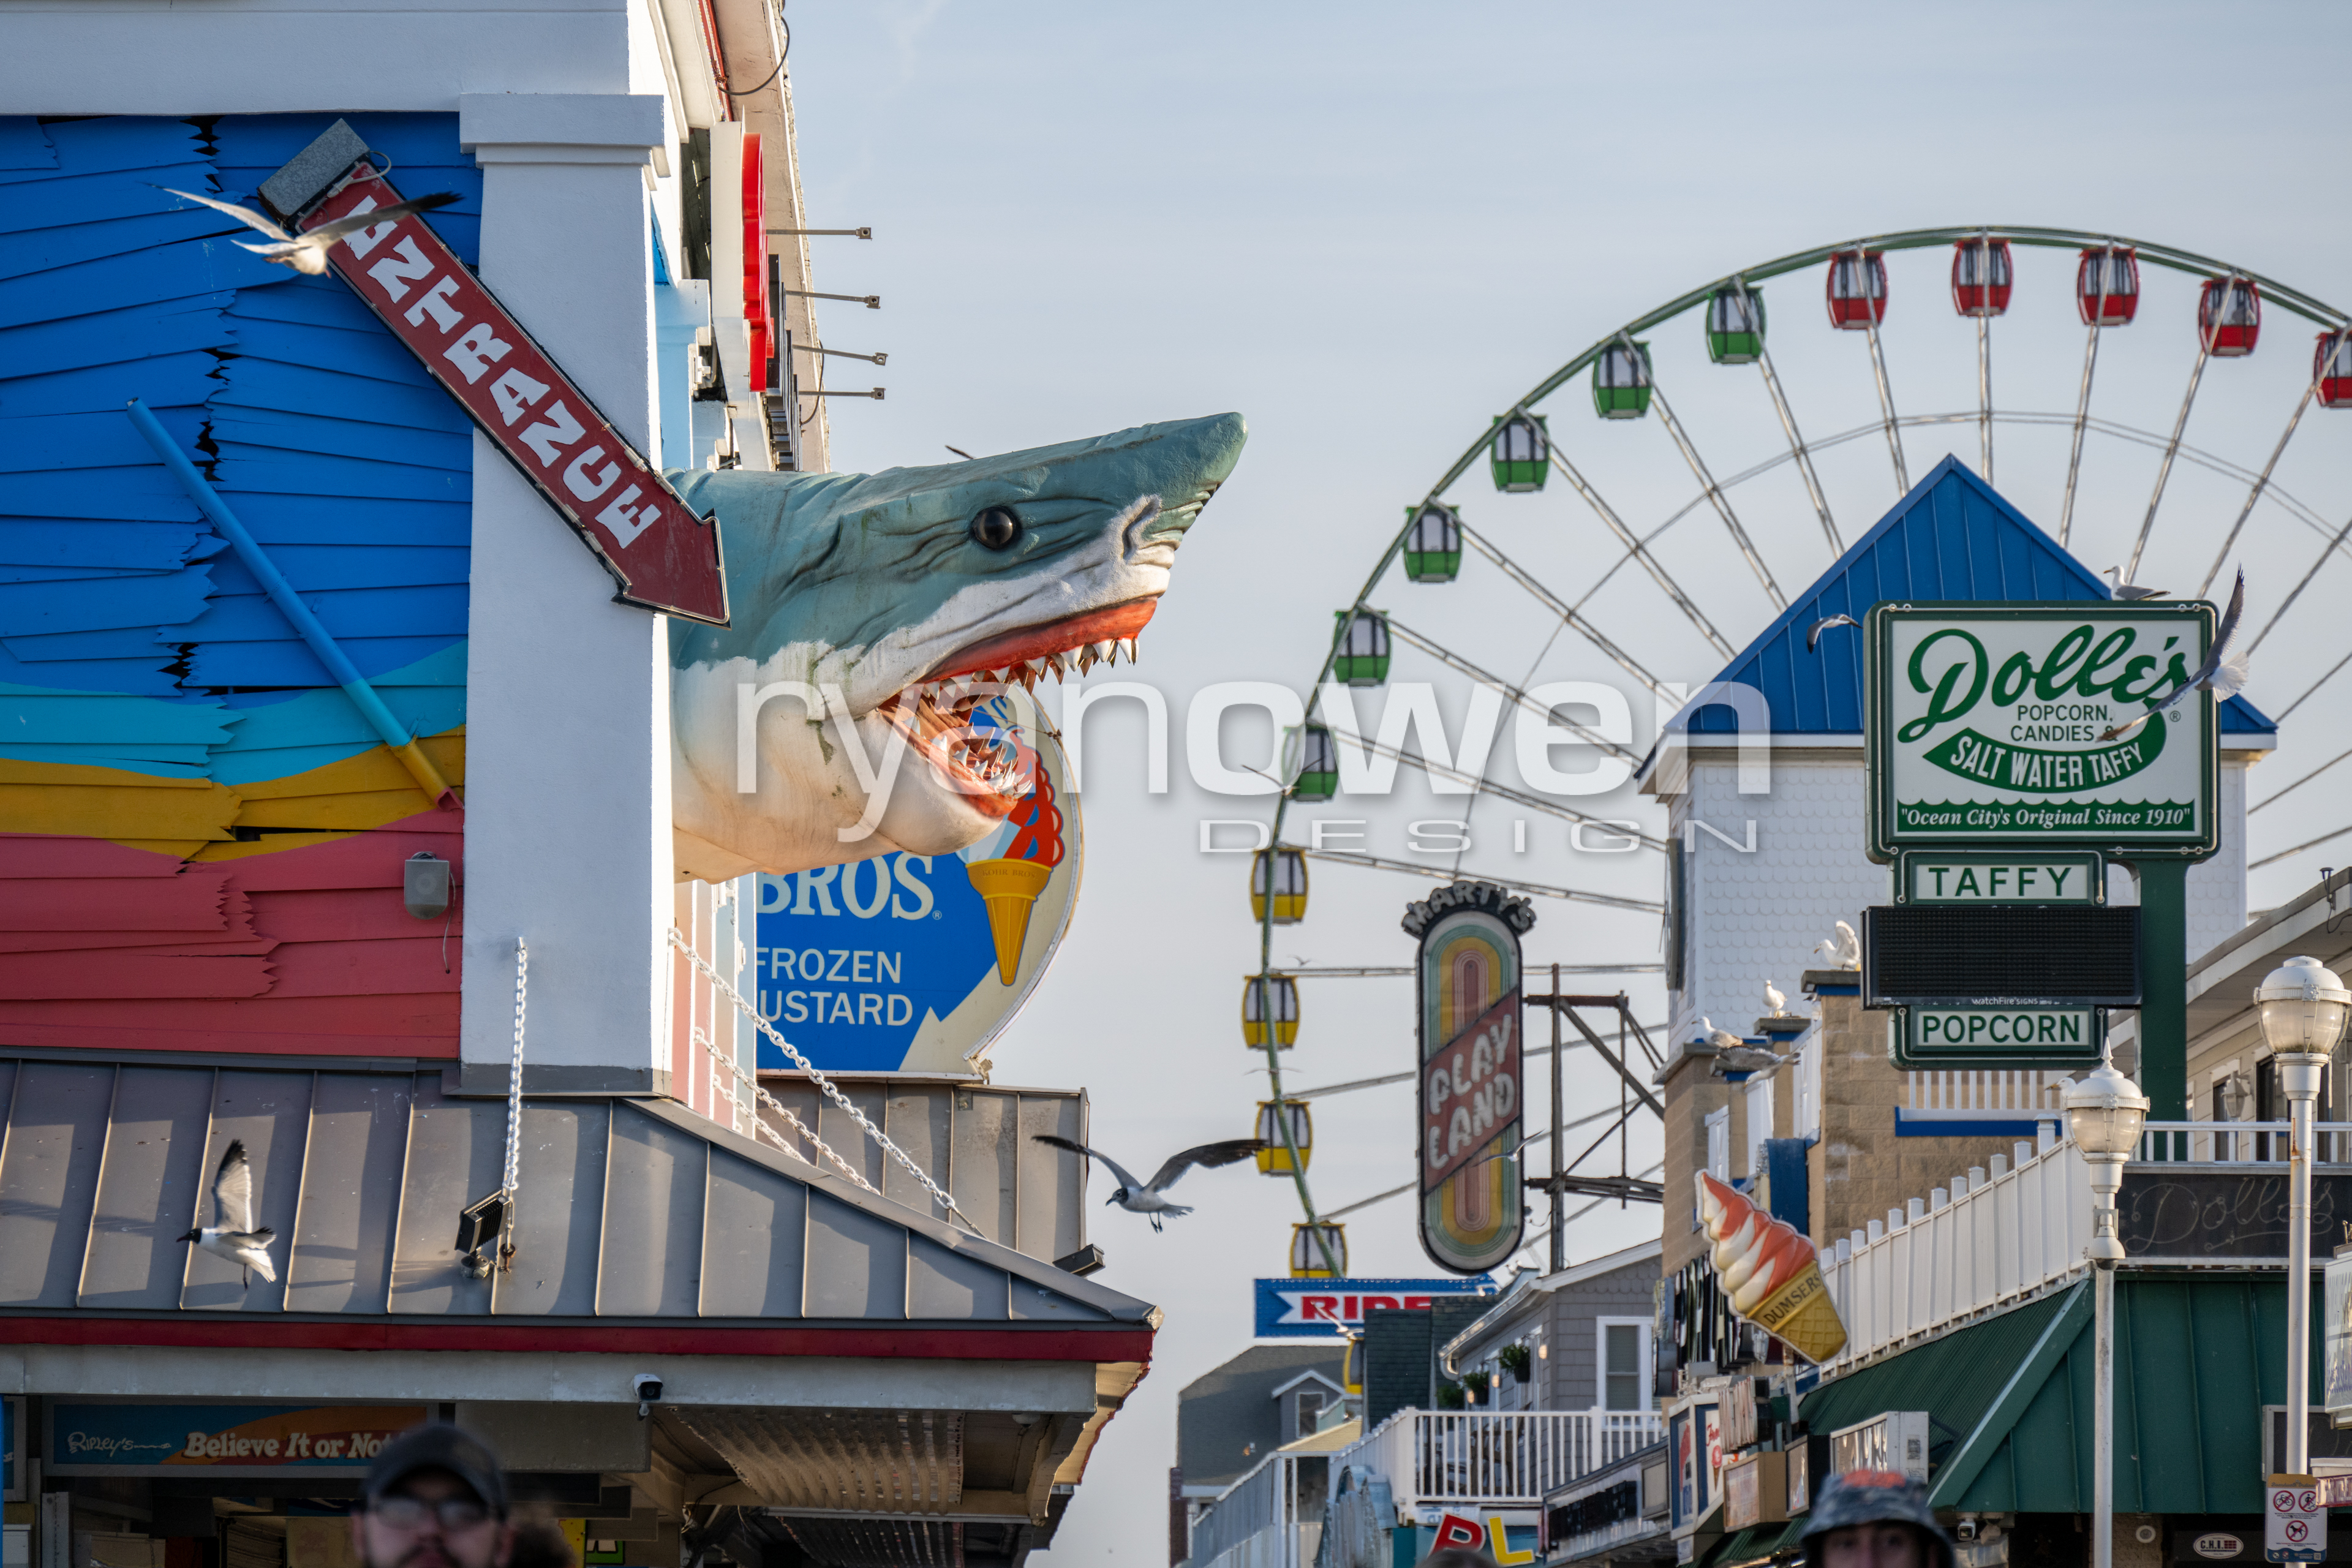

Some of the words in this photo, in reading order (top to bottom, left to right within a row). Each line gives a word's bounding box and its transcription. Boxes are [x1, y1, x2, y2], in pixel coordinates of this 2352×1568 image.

[341, 195, 662, 549] ENTRANCE
[1898, 624, 2192, 742] Dolle's
[2018, 704, 2114, 722] POPCORN,
[2010, 725, 2095, 742] CANDIES
[1950, 736, 2007, 780] SALT
[2010, 751, 2084, 788] WATER
[2088, 742, 2144, 783] TAFFY
[1901, 808, 1961, 825] "Ocean
[1966, 808, 2010, 829] City's
[2016, 808, 2090, 829] Original
[2095, 809, 2141, 825] Since
[2145, 808, 2191, 825] 1910"
[982, 869, 1008, 877] KOHR
[1928, 867, 2072, 897] TAFFY
[759, 989, 913, 1027] USTARD
[1922, 1014, 2081, 1043] POPCORN
[1429, 1014, 1512, 1115] PLAY
[1428, 1073, 1516, 1170] LAND
[1763, 1273, 1822, 1325] DUMSERS
[184, 1431, 279, 1457] Believe
[284, 1432, 311, 1457] It
[315, 1439, 345, 1458] or
[2200, 1540, 2224, 1550] C.H.I.
